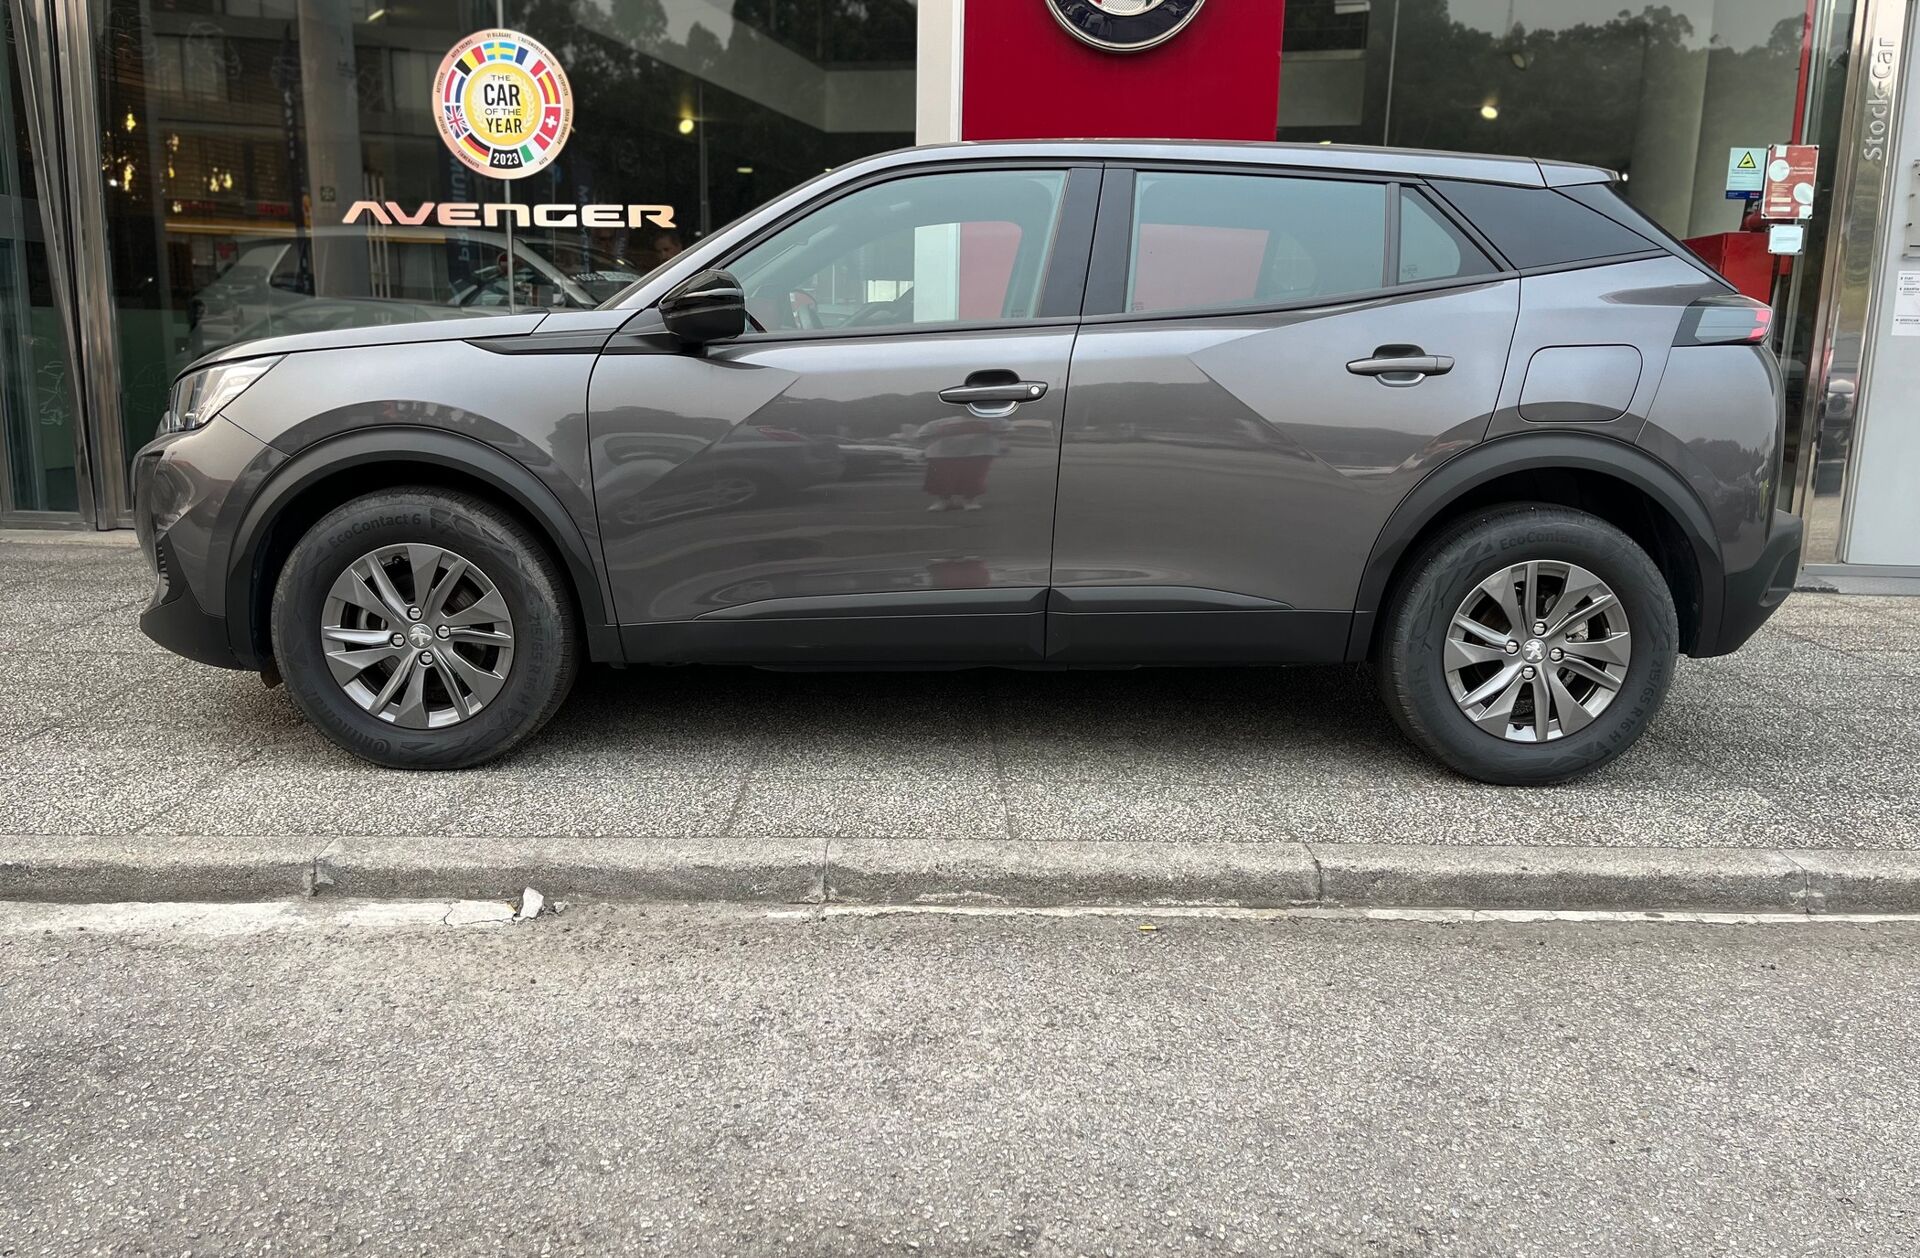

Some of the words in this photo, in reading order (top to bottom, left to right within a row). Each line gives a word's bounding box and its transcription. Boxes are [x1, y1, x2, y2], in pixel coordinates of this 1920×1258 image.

[484, 83, 521, 107] CAR
[1862, 36, 1896, 161] Stock-Car
[484, 107, 499, 116] OF
[501, 107, 522, 116] THE
[485, 117, 523, 134] YEAR
[492, 152, 520, 165] 2023
[342, 200, 678, 229] AVENGER
[328, 513, 409, 549] EcoContact
[413, 512, 422, 526] 6
[1642, 659, 1664, 706] 215/65
[1631, 705, 1645, 718] R
[1618, 717, 1634, 733] 16
[1609, 730, 1623, 743] H
